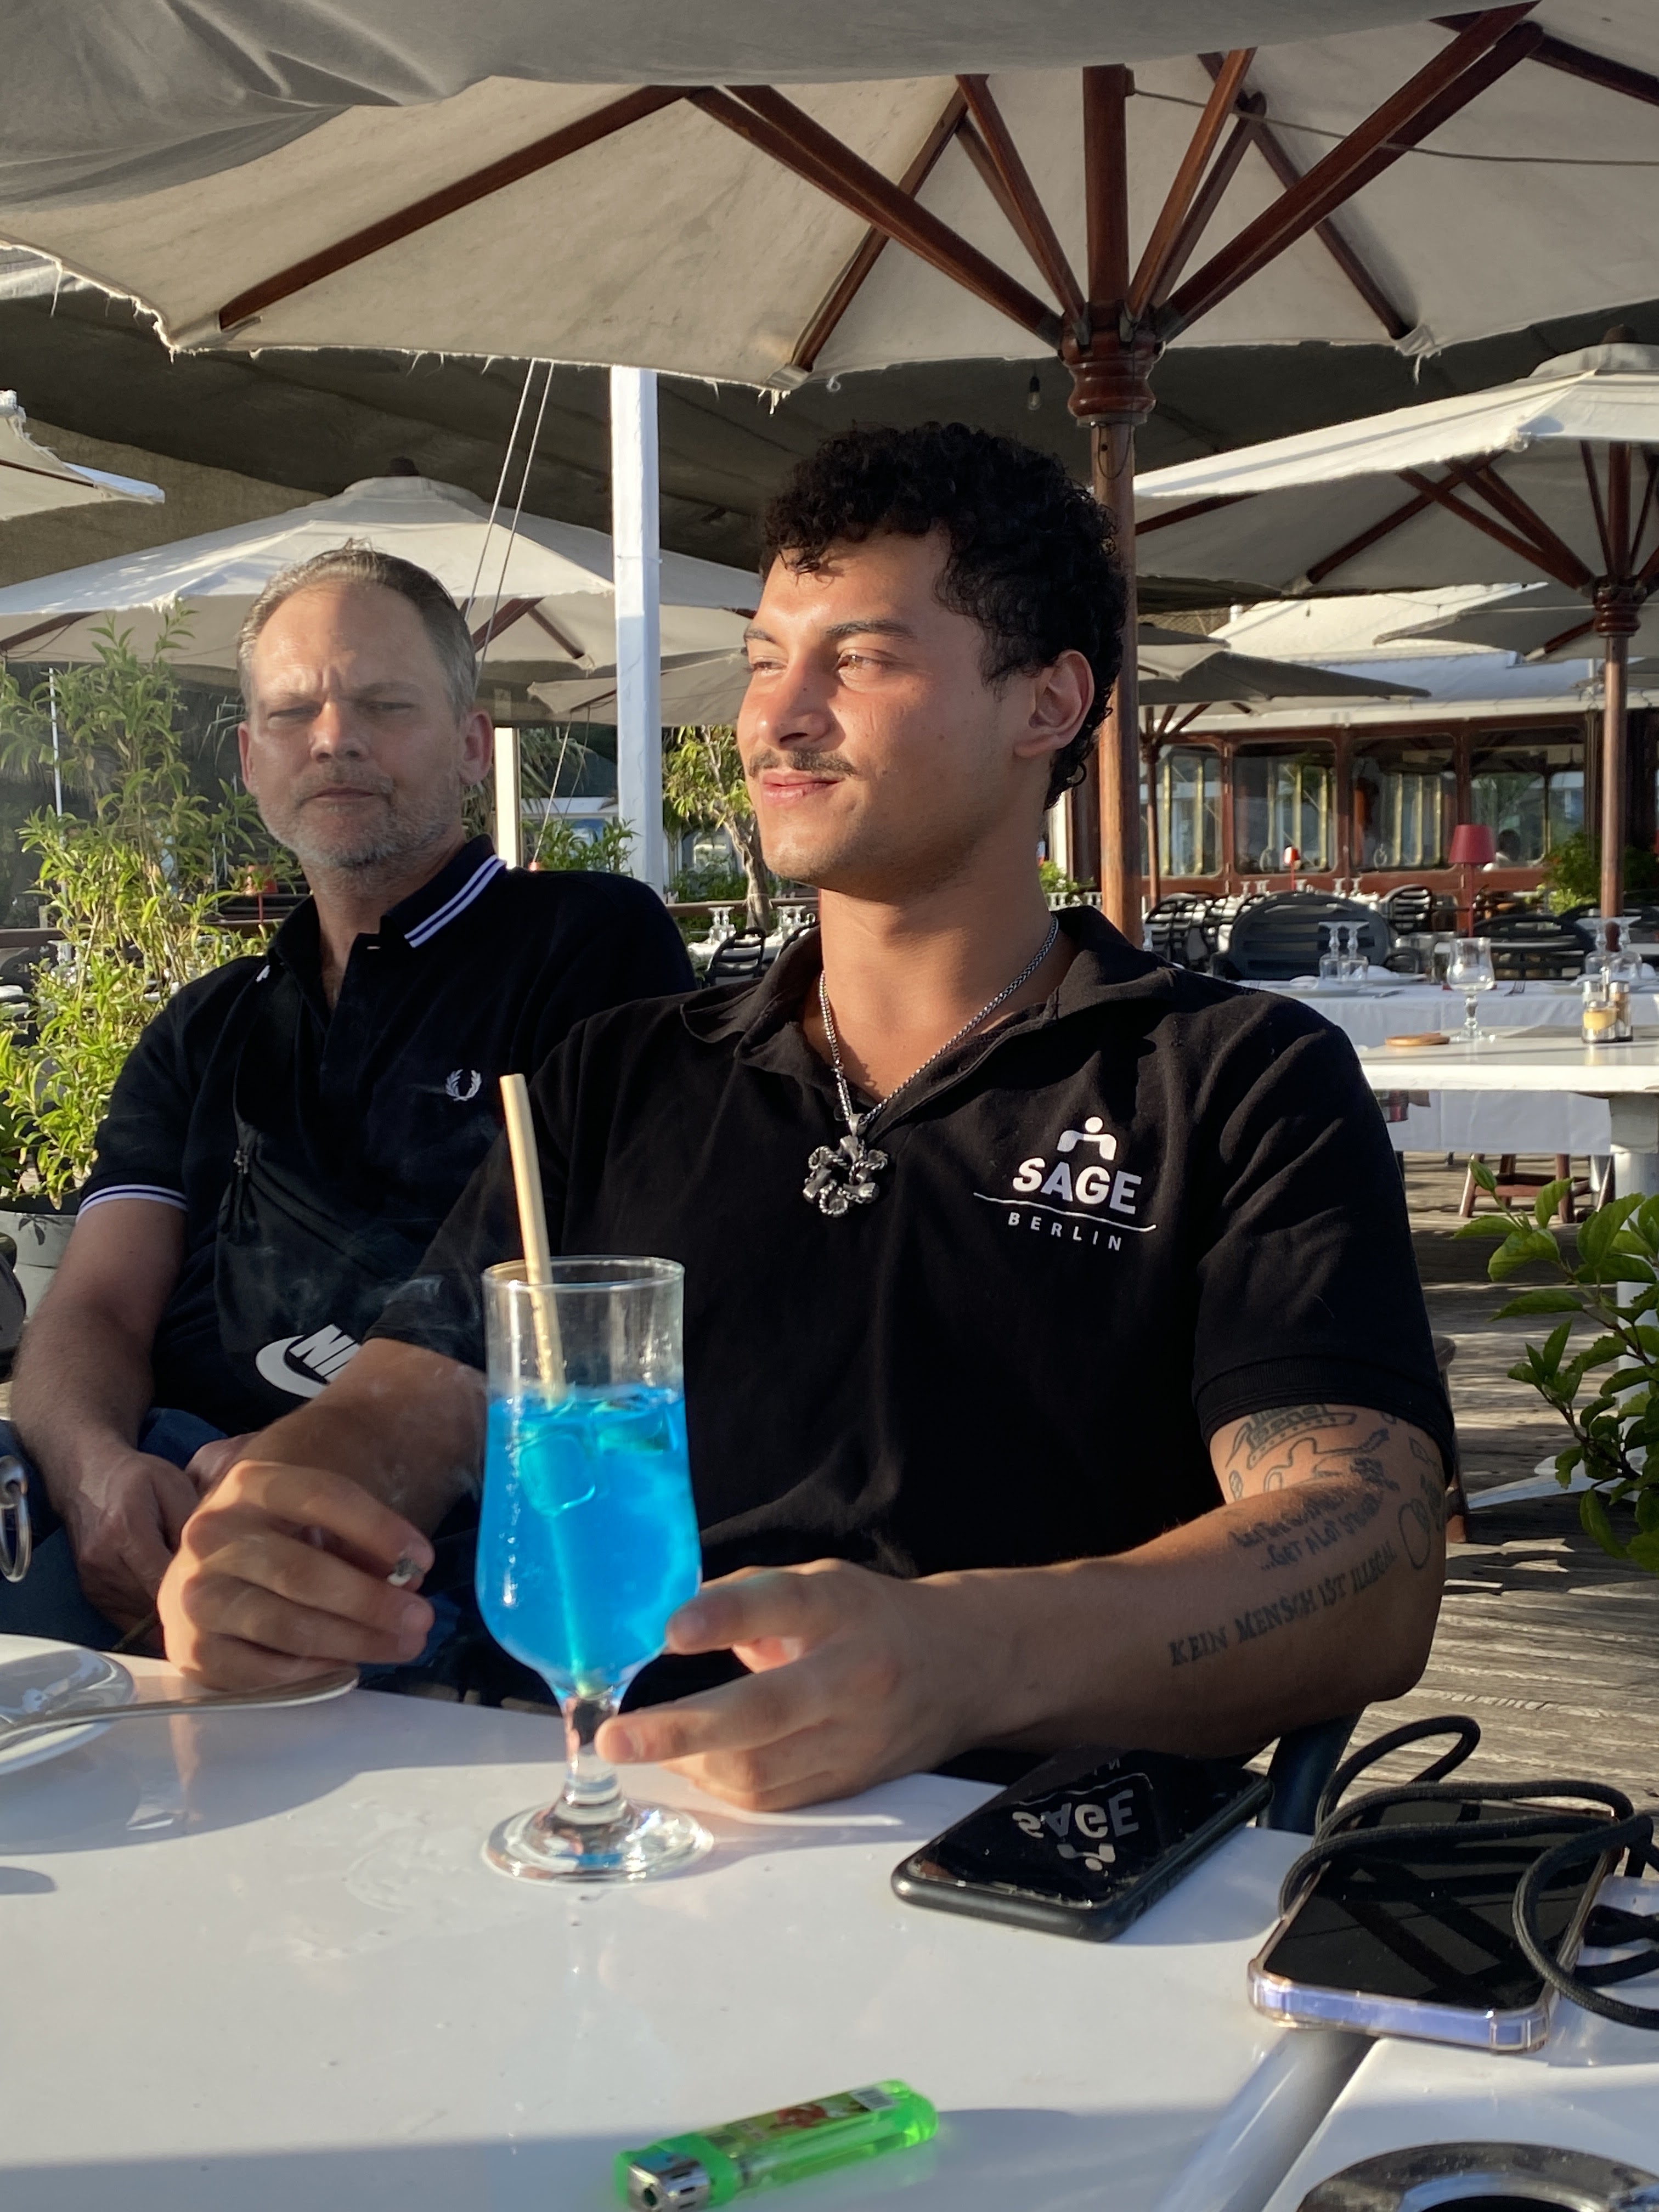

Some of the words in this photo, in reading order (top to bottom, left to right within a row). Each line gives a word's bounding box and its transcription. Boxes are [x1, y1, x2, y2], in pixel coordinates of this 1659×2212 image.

[1012, 1157, 1142, 1214] SAGE
[1008, 1212, 1122, 1251] BERLIN
[289, 1323, 362, 1384] NI
[1168, 1626, 1227, 1667] KEIN
[1234, 1588, 1318, 1644] MENSCH
[1319, 1572, 1347, 1608] IST
